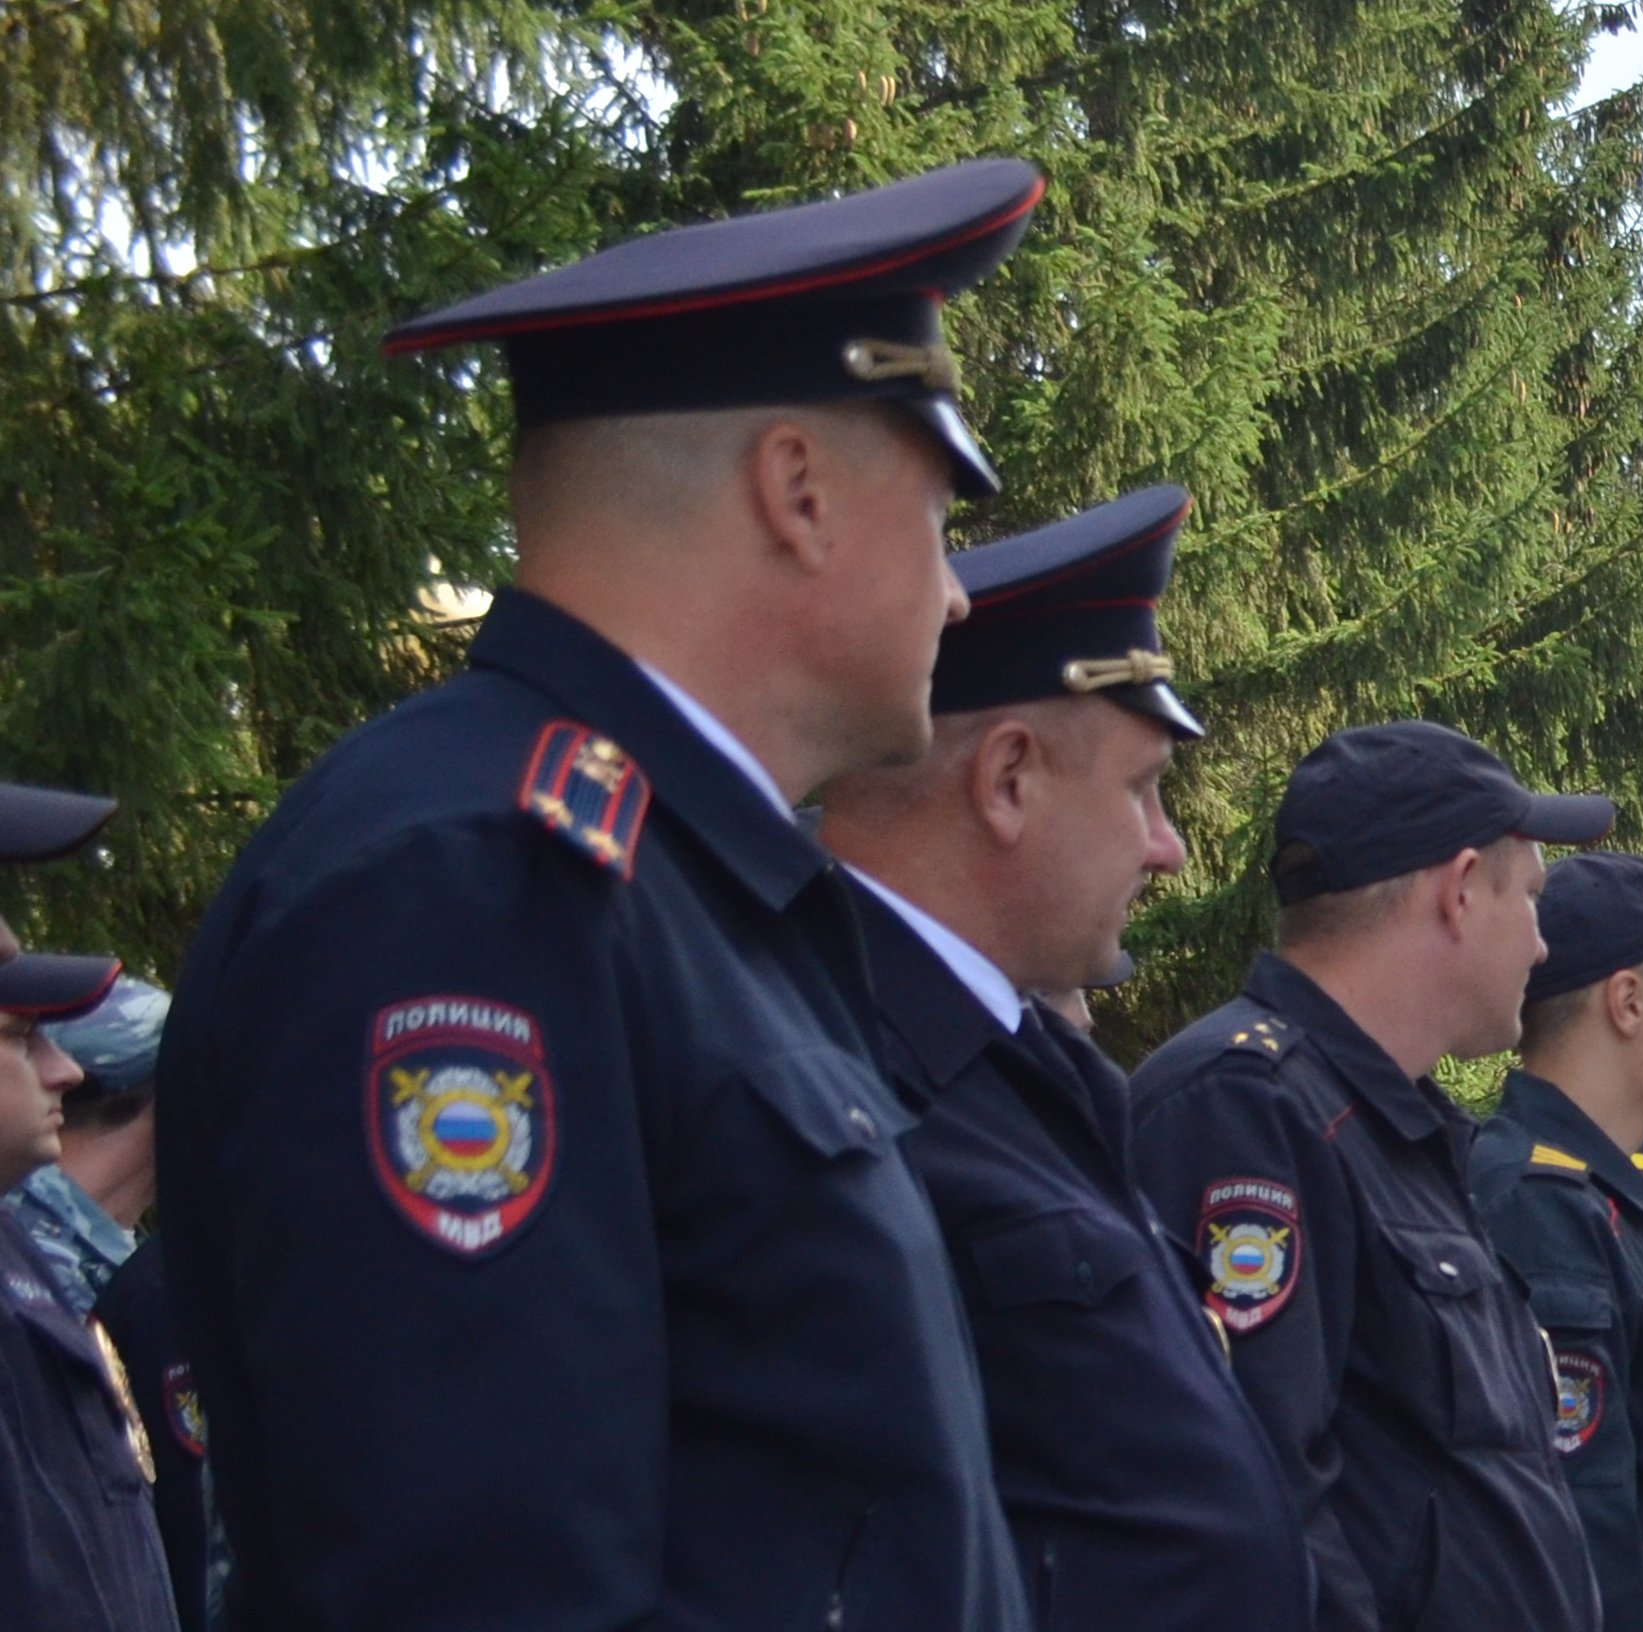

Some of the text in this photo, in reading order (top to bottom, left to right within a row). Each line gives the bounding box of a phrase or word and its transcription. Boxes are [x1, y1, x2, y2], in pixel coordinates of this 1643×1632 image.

[385, 1001, 531, 1044] ПОЛИЦИЯ
[1209, 1183, 1293, 1210] ПОЛИЦИЯ
[437, 1209, 503, 1250] МВД
